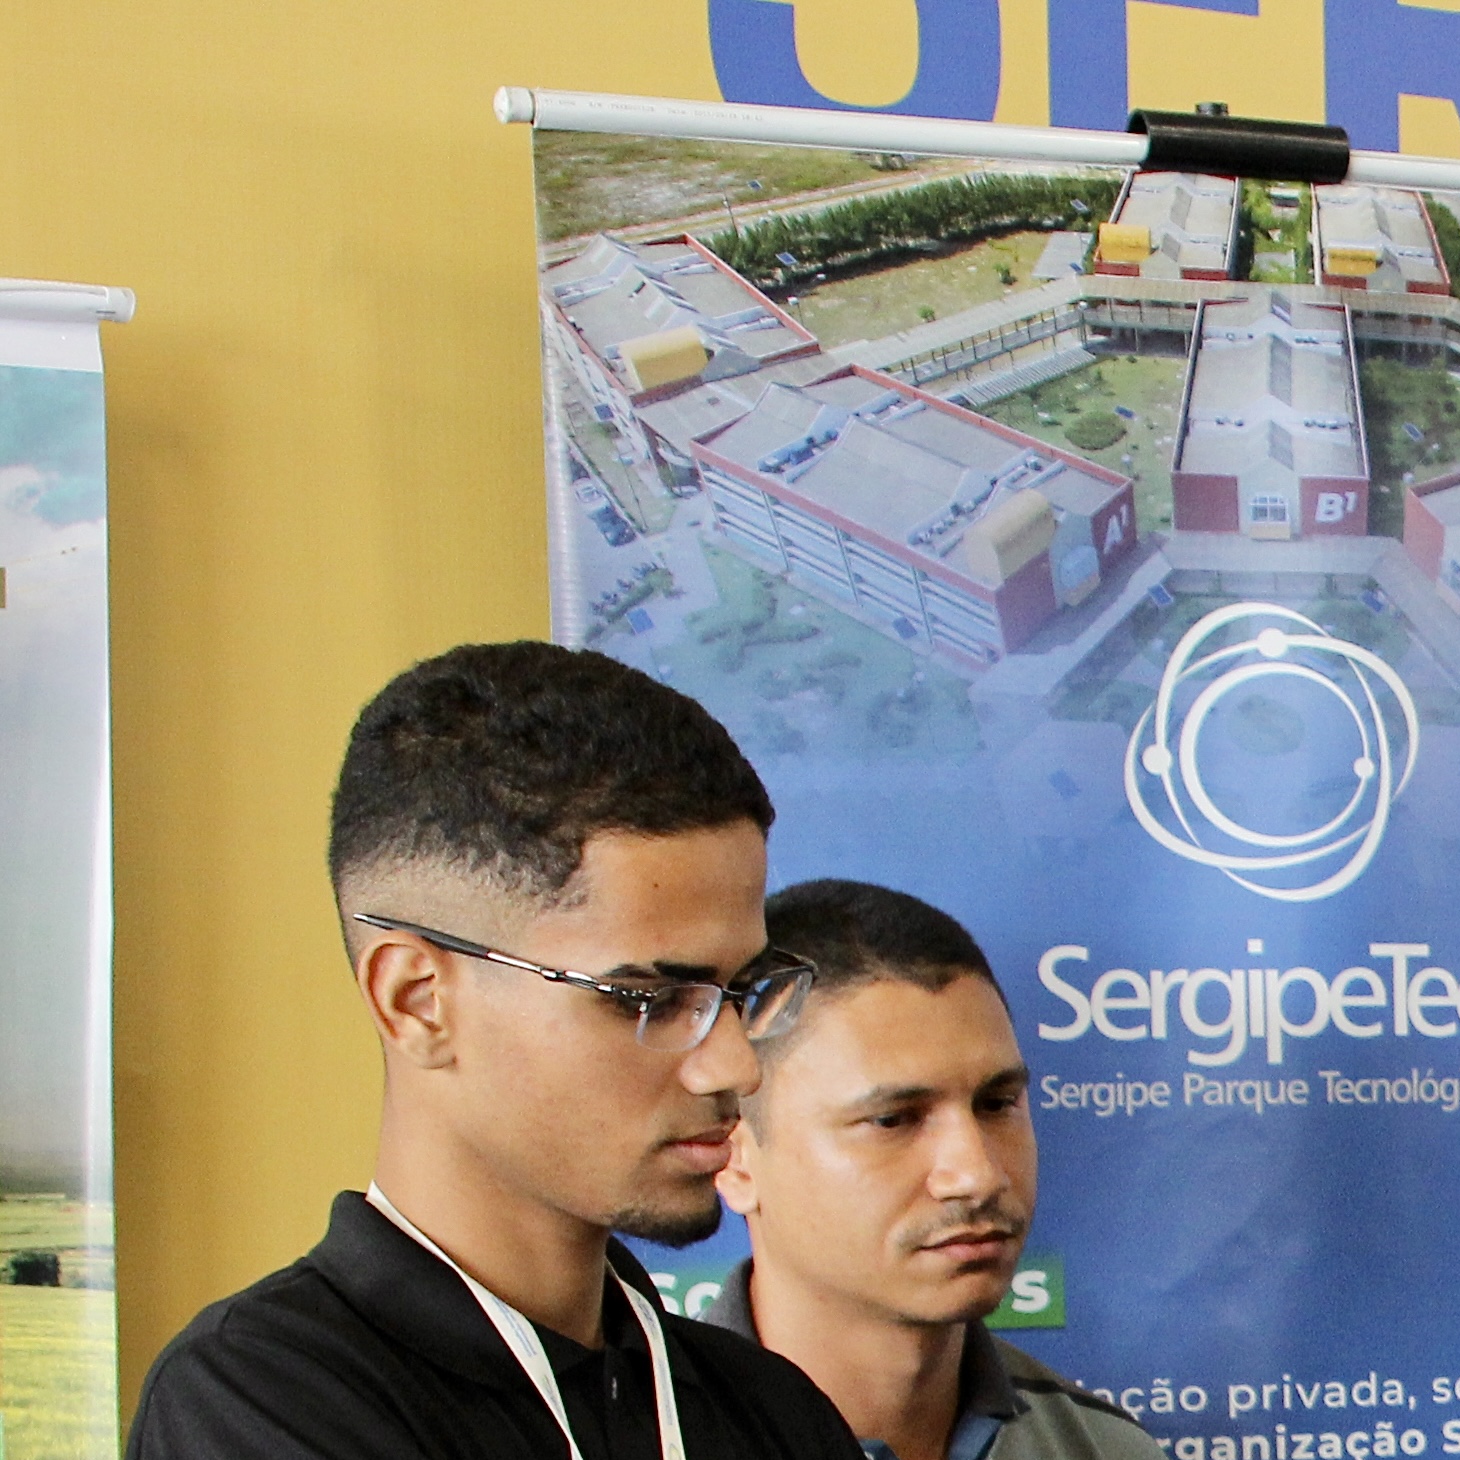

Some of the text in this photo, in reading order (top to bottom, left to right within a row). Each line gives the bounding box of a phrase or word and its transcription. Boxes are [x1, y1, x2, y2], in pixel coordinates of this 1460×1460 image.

[1040, 1070, 1171, 1117] Sergipe
[1183, 1070, 1309, 1115] Parque
[1228, 1371, 1417, 1419] privada,
